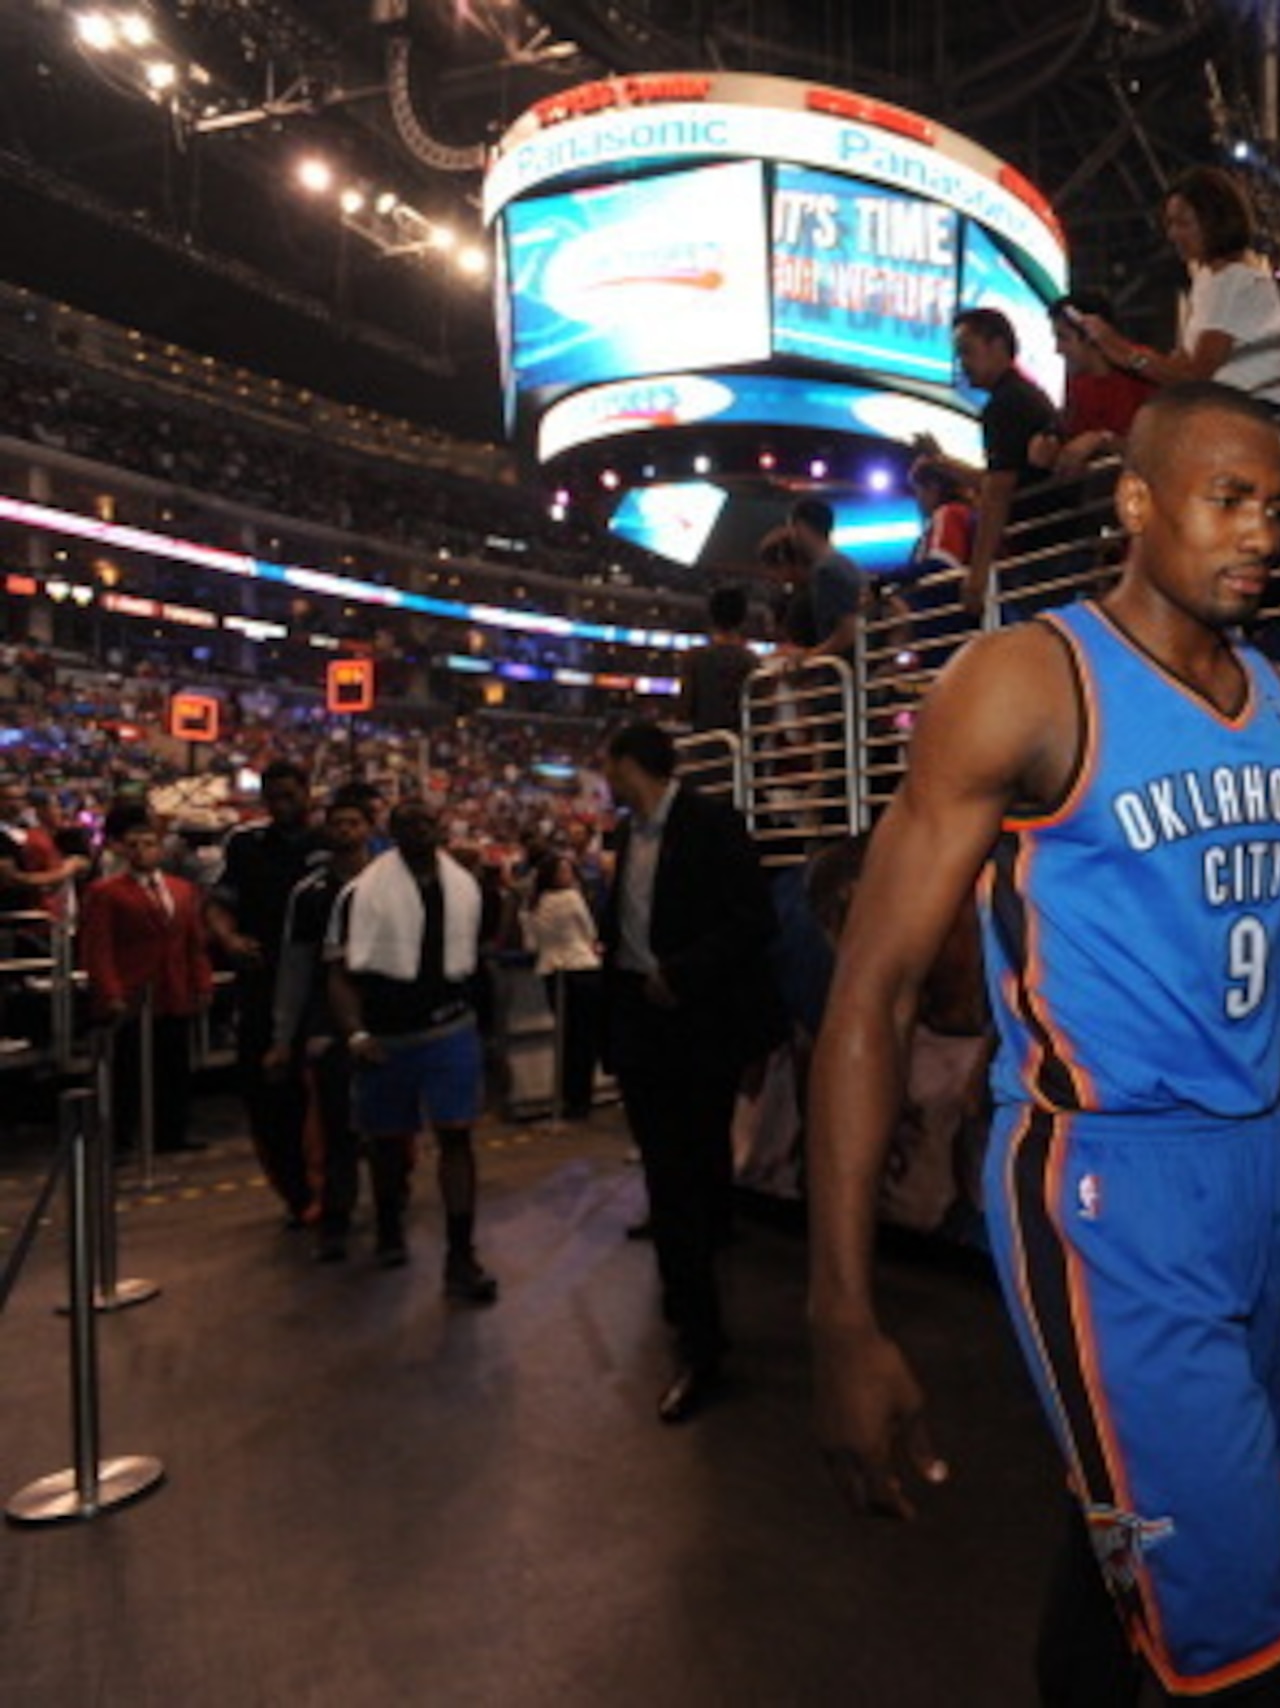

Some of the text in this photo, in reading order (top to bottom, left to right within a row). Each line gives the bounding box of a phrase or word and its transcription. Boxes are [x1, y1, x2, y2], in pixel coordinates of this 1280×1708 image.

[517, 118, 728, 172] Panasonic
[855, 197, 955, 267] TIME
[1225, 914, 1268, 1019] 9
